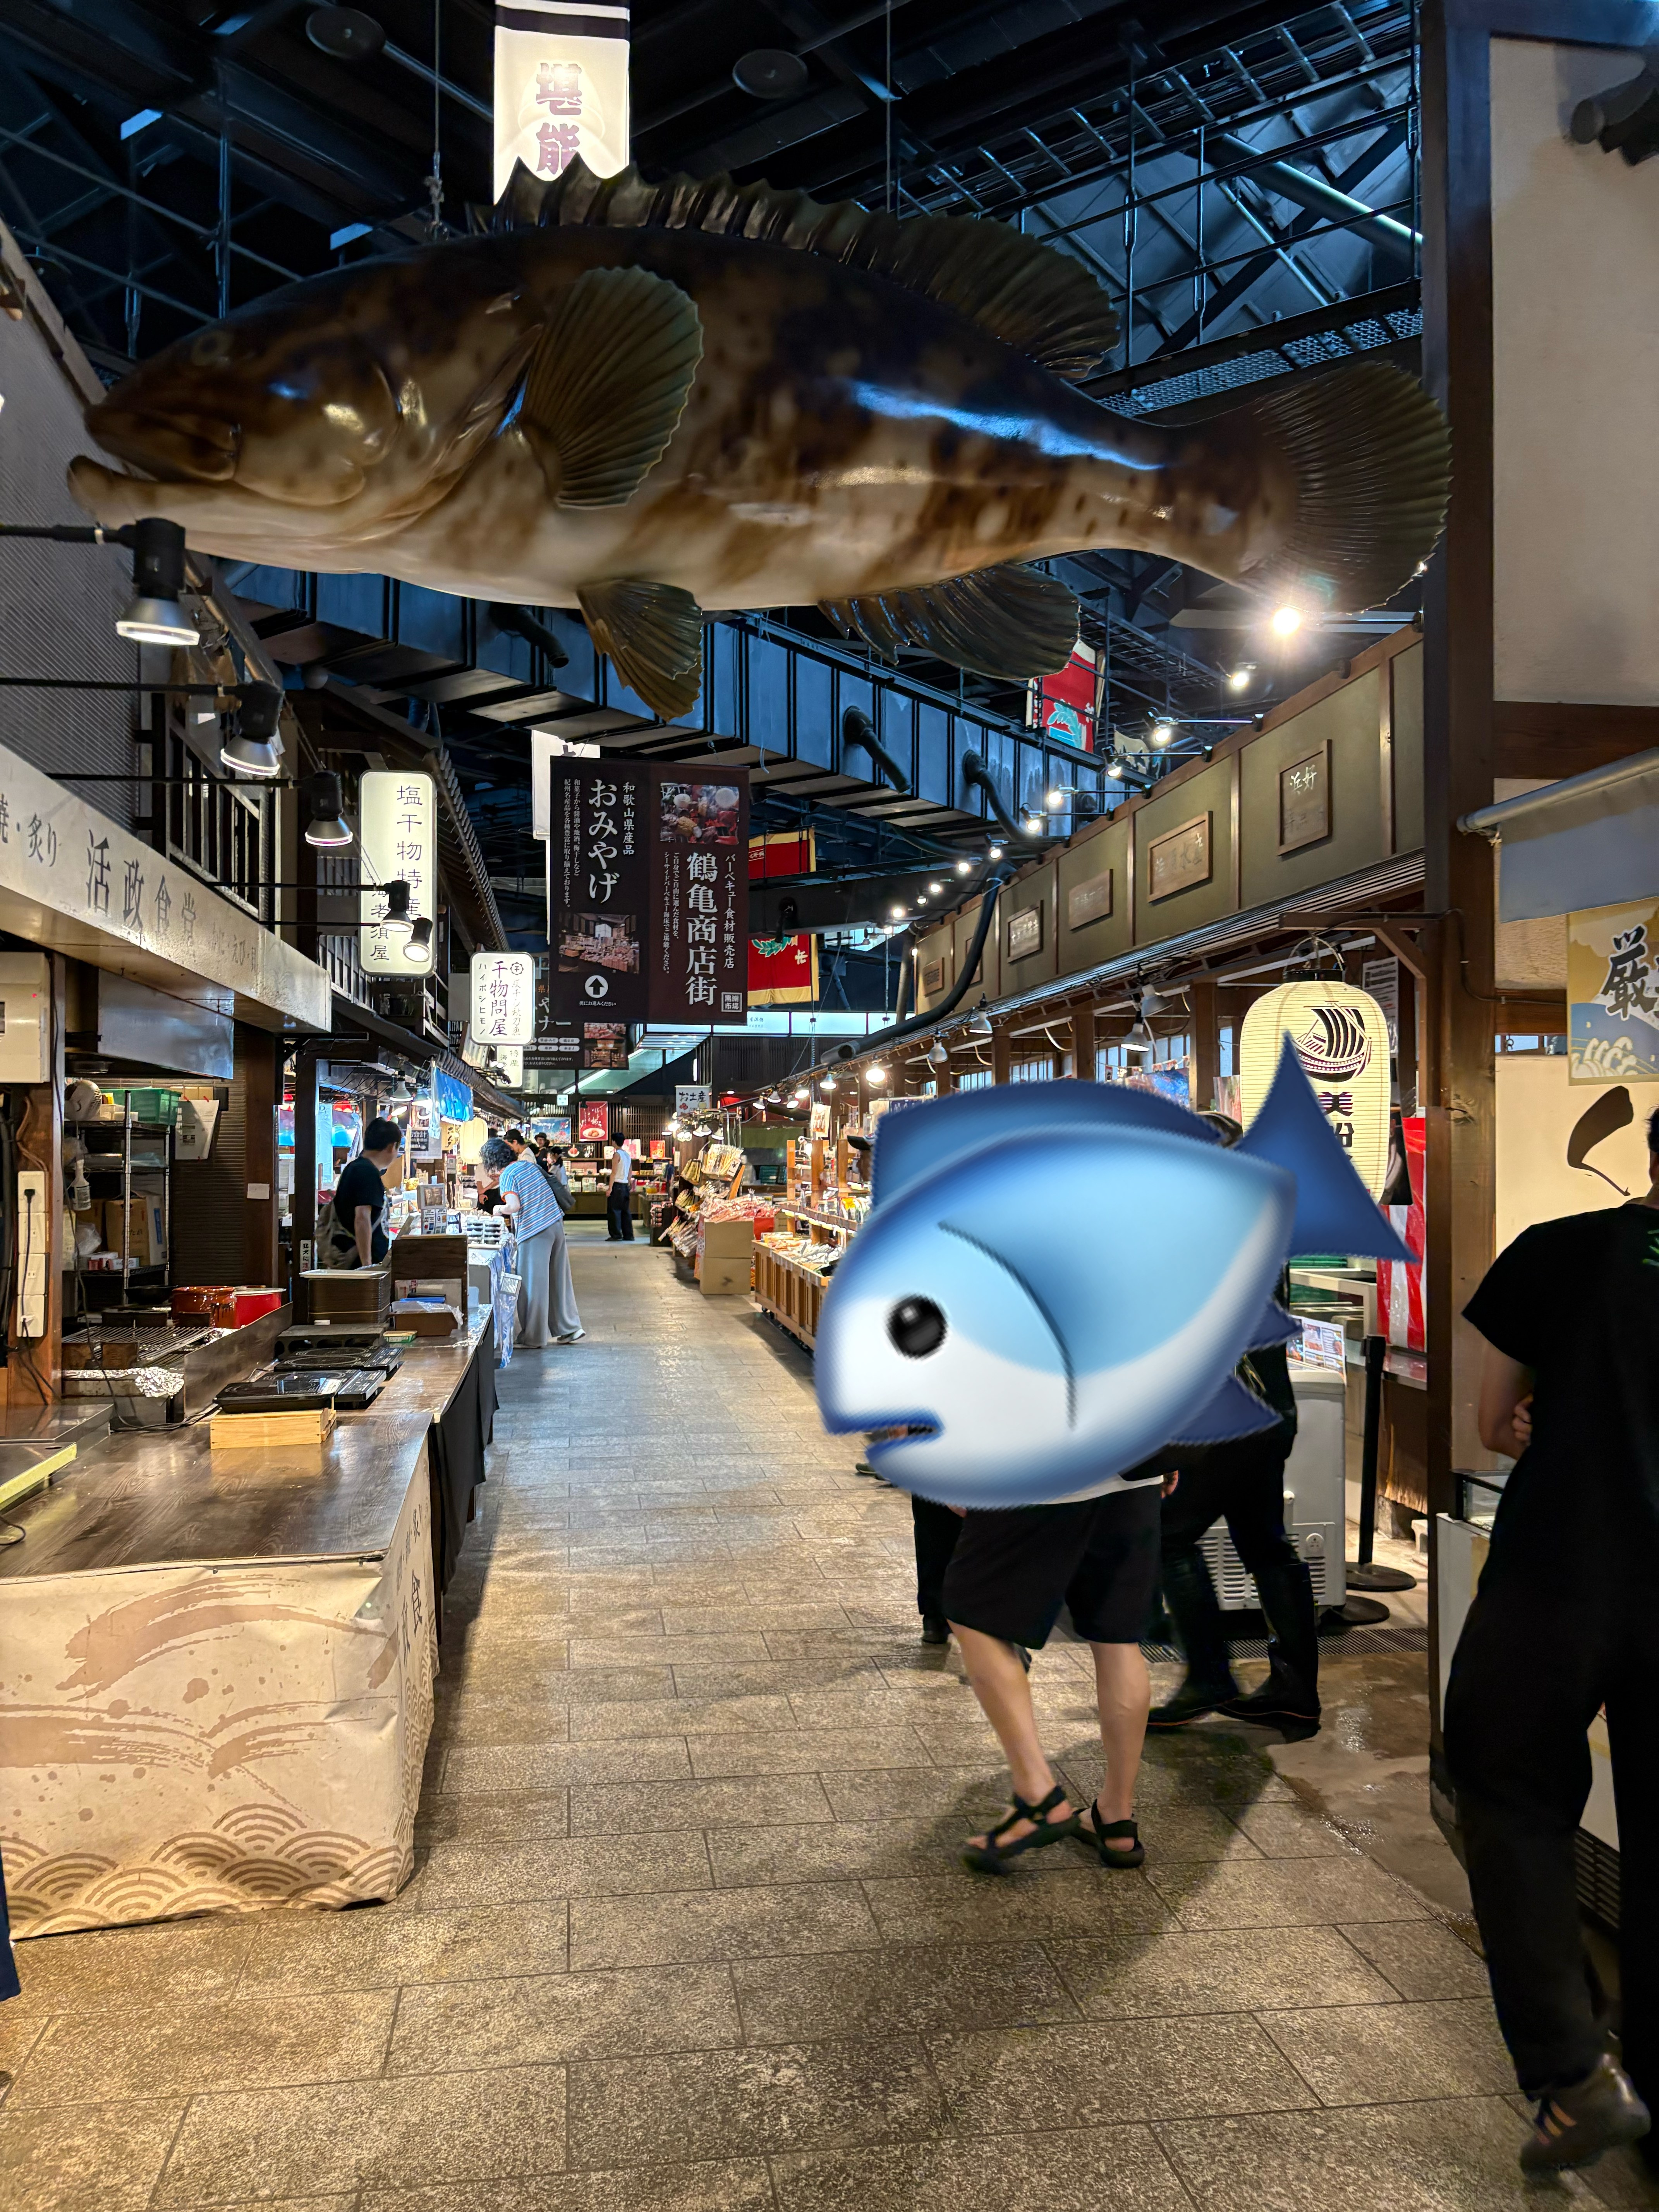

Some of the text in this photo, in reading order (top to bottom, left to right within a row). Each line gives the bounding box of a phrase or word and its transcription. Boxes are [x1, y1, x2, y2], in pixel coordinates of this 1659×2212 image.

[588, 780, 620, 903] おみやげ
[623, 782, 635, 855] 和歌山県産品
[685, 852, 718, 1006] 鶴亀商店街
[723, 854, 736, 969] バーベキュー食材販売店
[489, 961, 508, 1036] 干物問屋
[1601, 926, 1659, 1019] 厳
[679, 1091, 706, 1102] お土産
